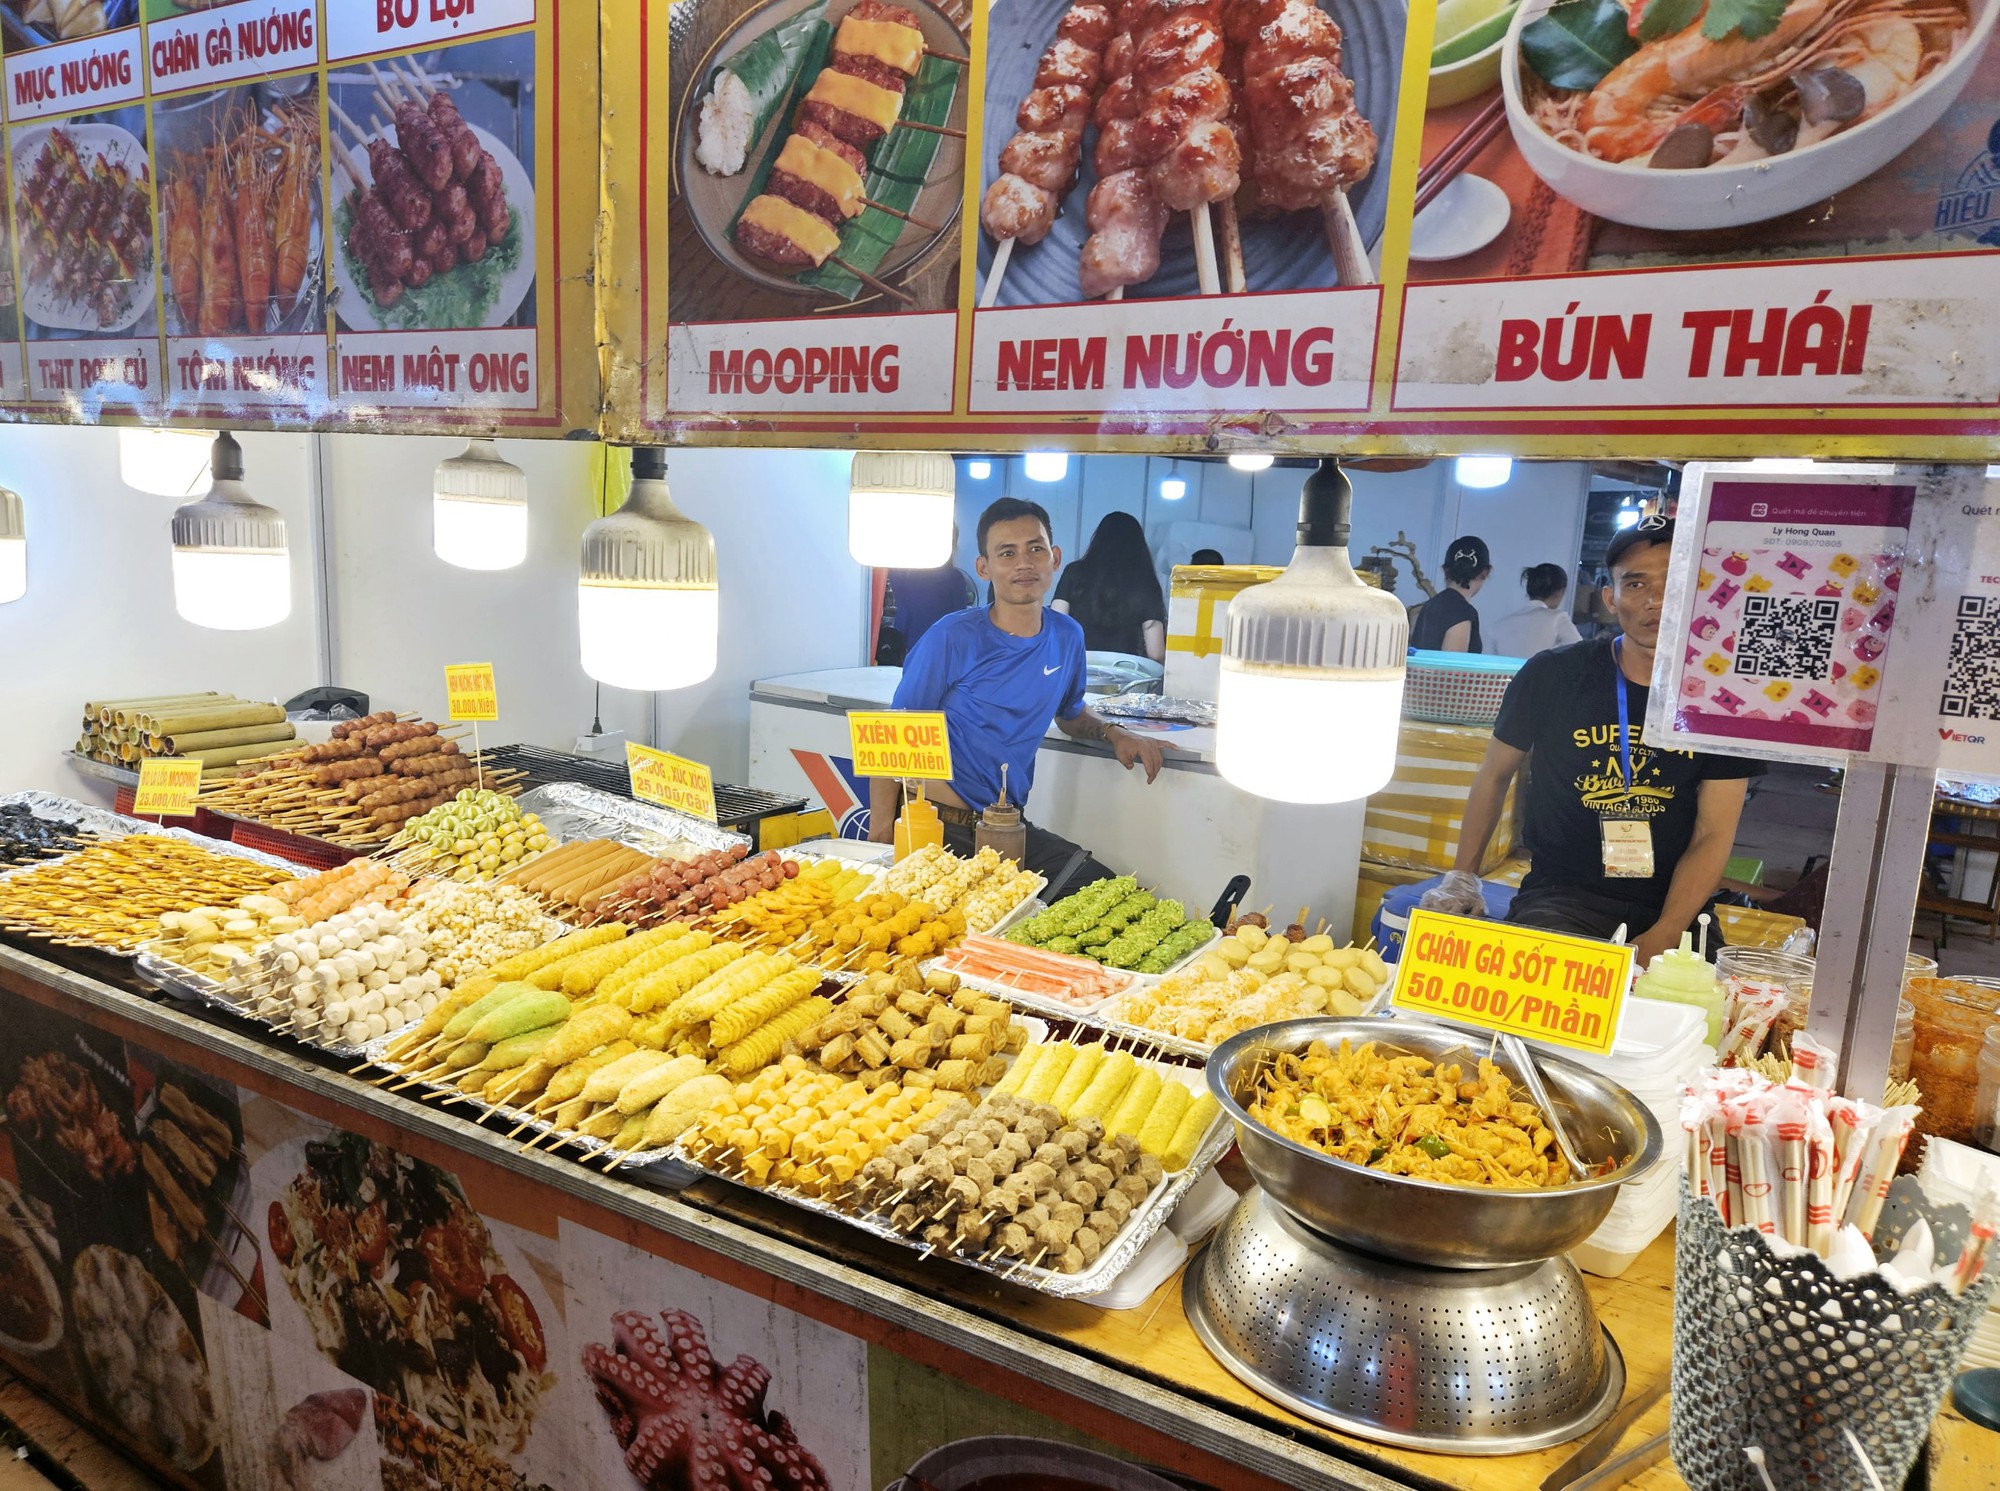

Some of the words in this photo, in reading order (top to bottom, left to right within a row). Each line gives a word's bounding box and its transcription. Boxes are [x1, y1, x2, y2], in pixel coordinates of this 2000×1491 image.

[152, 29, 200, 77] CHÂN
[206, 18, 232, 66] GÀ
[238, 7, 313, 61] NƯỚNG
[15, 65, 56, 109] MỤC
[61, 48, 131, 96] NƯỚNG
[996, 336, 1106, 392] NEM
[1123, 318, 1334, 390] NƯỚNG
[1495, 301, 1652, 382] BÚN
[1682, 289, 1873, 377] THÁI
[123, 348, 148, 390] CỦ
[177, 349, 227, 390] TÔM
[232, 348, 315, 391] NƯỚNG
[342, 354, 395, 392] NEM
[403, 345, 460, 400] MẬT
[468, 353, 530, 393] ONG
[708, 344, 900, 396] MOOPING
[1961, 504, 1992, 516] Quét
[1773, 527, 1783, 536] Ly
[1785, 527, 1809, 537] Hong
[1811, 528, 1836, 537] Quan
[451, 697, 496, 715] 30.000/Xiên
[856, 719, 898, 745] XIÊN
[904, 724, 942, 748] QUE
[168, 770, 198, 788] MOOPING
[671, 763, 689, 787] XÚC
[689, 768, 708, 793] XÍCH
[859, 750, 945, 771] 20.000/Xiên
[1415, 930, 1471, 969] CHÂN
[1475, 938, 1506, 977] GÀ
[1508, 942, 1558, 987] SỐT
[1562, 958, 1615, 1000] THÁI
[1407, 971, 1602, 1039] 50.000/Phần
